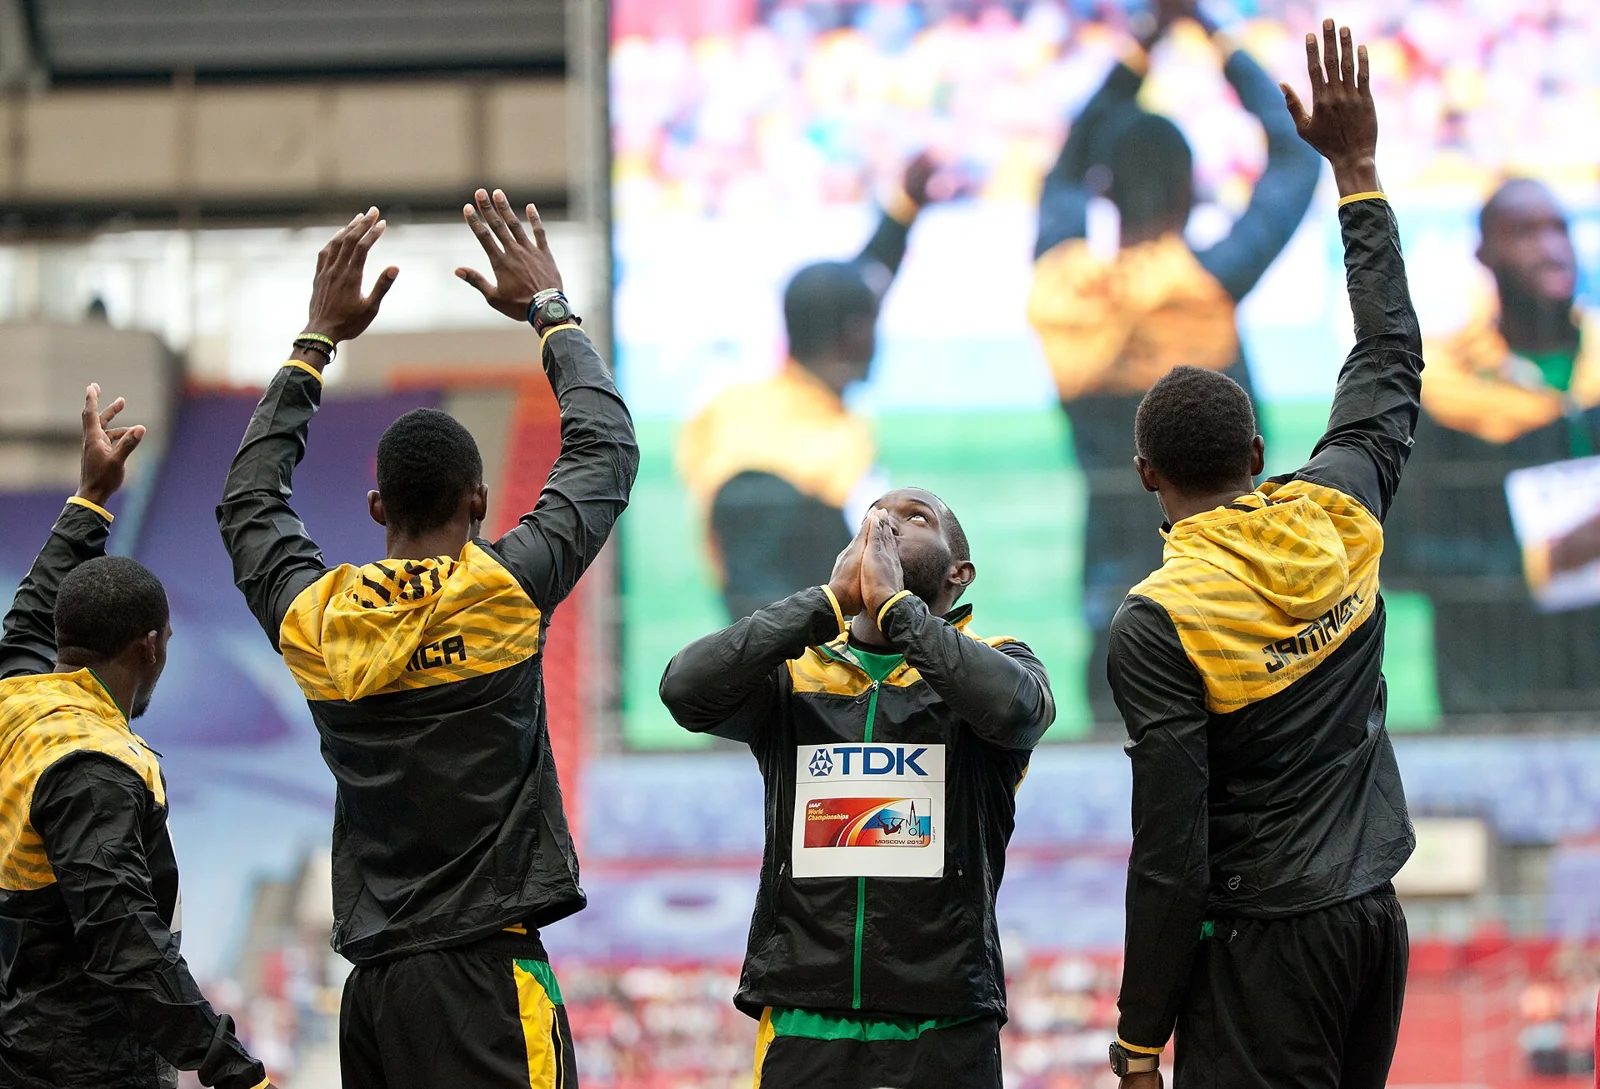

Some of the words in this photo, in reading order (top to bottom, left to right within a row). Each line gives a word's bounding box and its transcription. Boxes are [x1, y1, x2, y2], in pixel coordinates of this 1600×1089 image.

[406, 635, 467, 672] ICA
[833, 747, 929, 777] TDK
[807, 813, 849, 821] Championships
